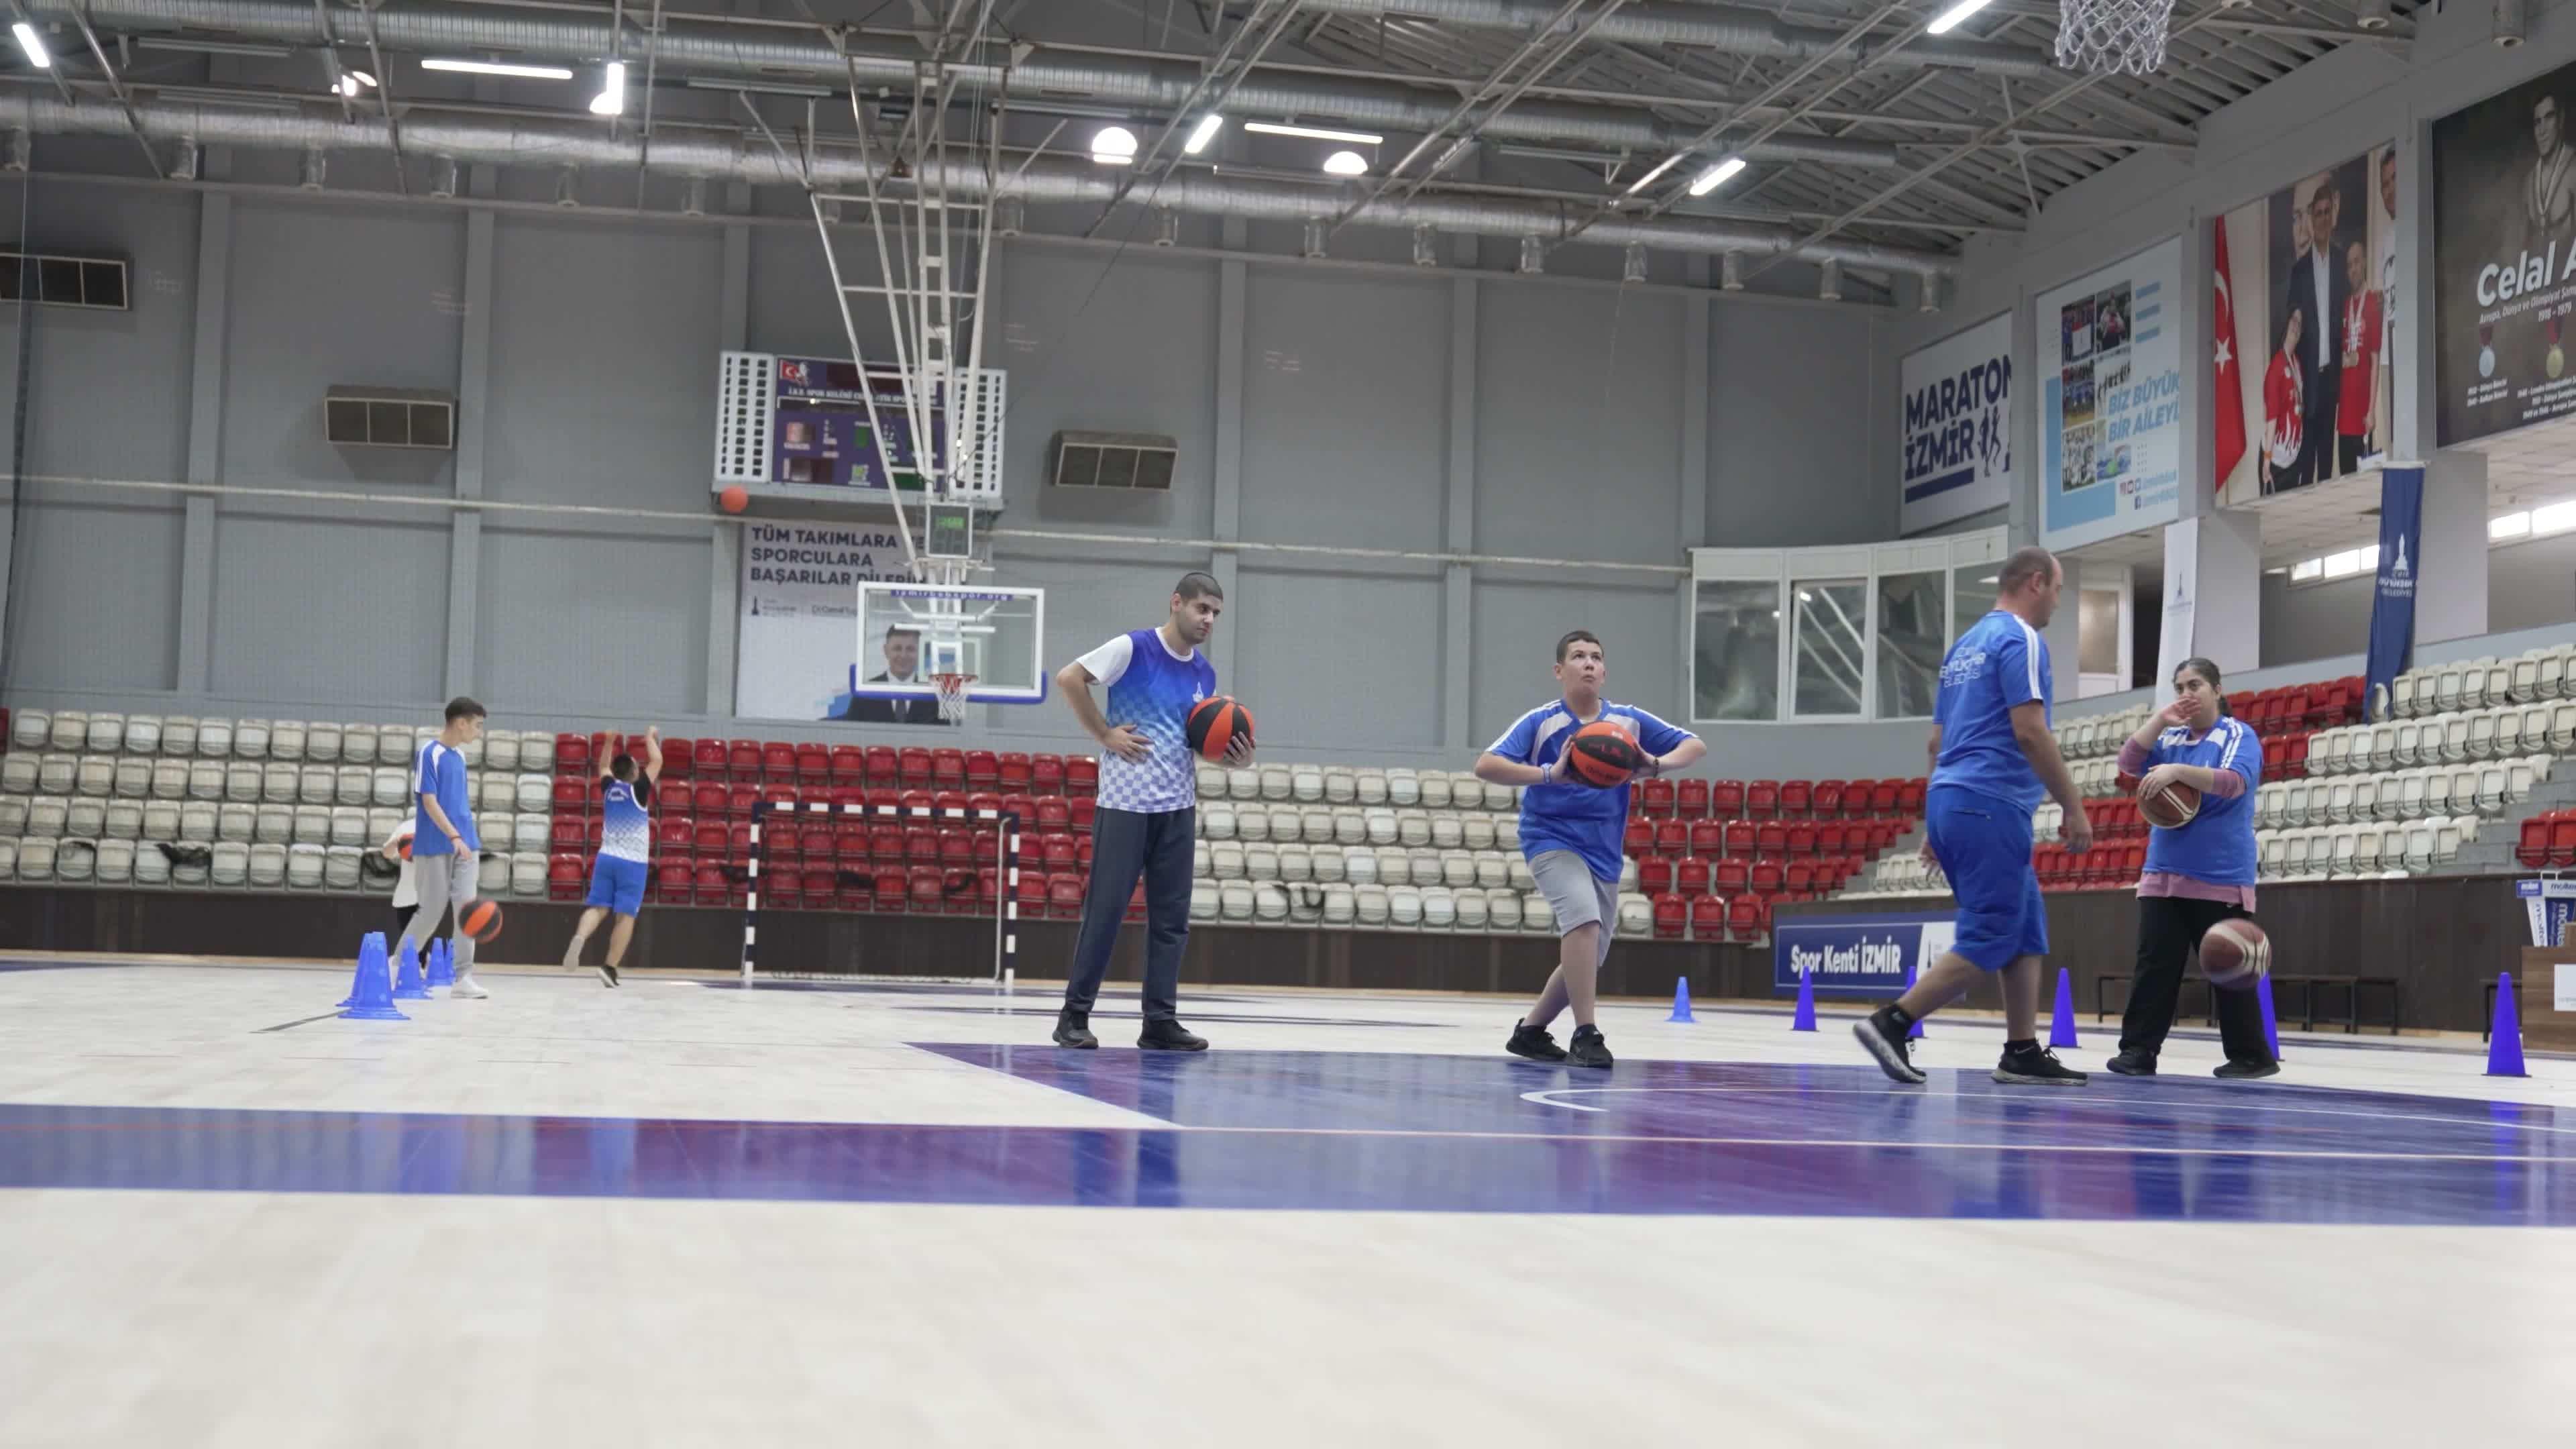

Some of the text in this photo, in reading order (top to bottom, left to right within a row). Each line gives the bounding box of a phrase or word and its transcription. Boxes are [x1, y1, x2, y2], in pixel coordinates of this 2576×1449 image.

[2477, 239, 2557, 307] Celal
[2108, 387, 2129, 415] BİZ
[2108, 398, 2179, 442] BİR AİLEYİ
[1904, 418, 1974, 483] İZMİR
[752, 524, 790, 543] TÜM
[796, 530, 898, 548] TAKIMLARA
[751, 547, 873, 567] SPORCULARA
[751, 567, 851, 586] BAŞARILAR
[1790, 935, 1902, 979] Spor Kenti İZMİR
